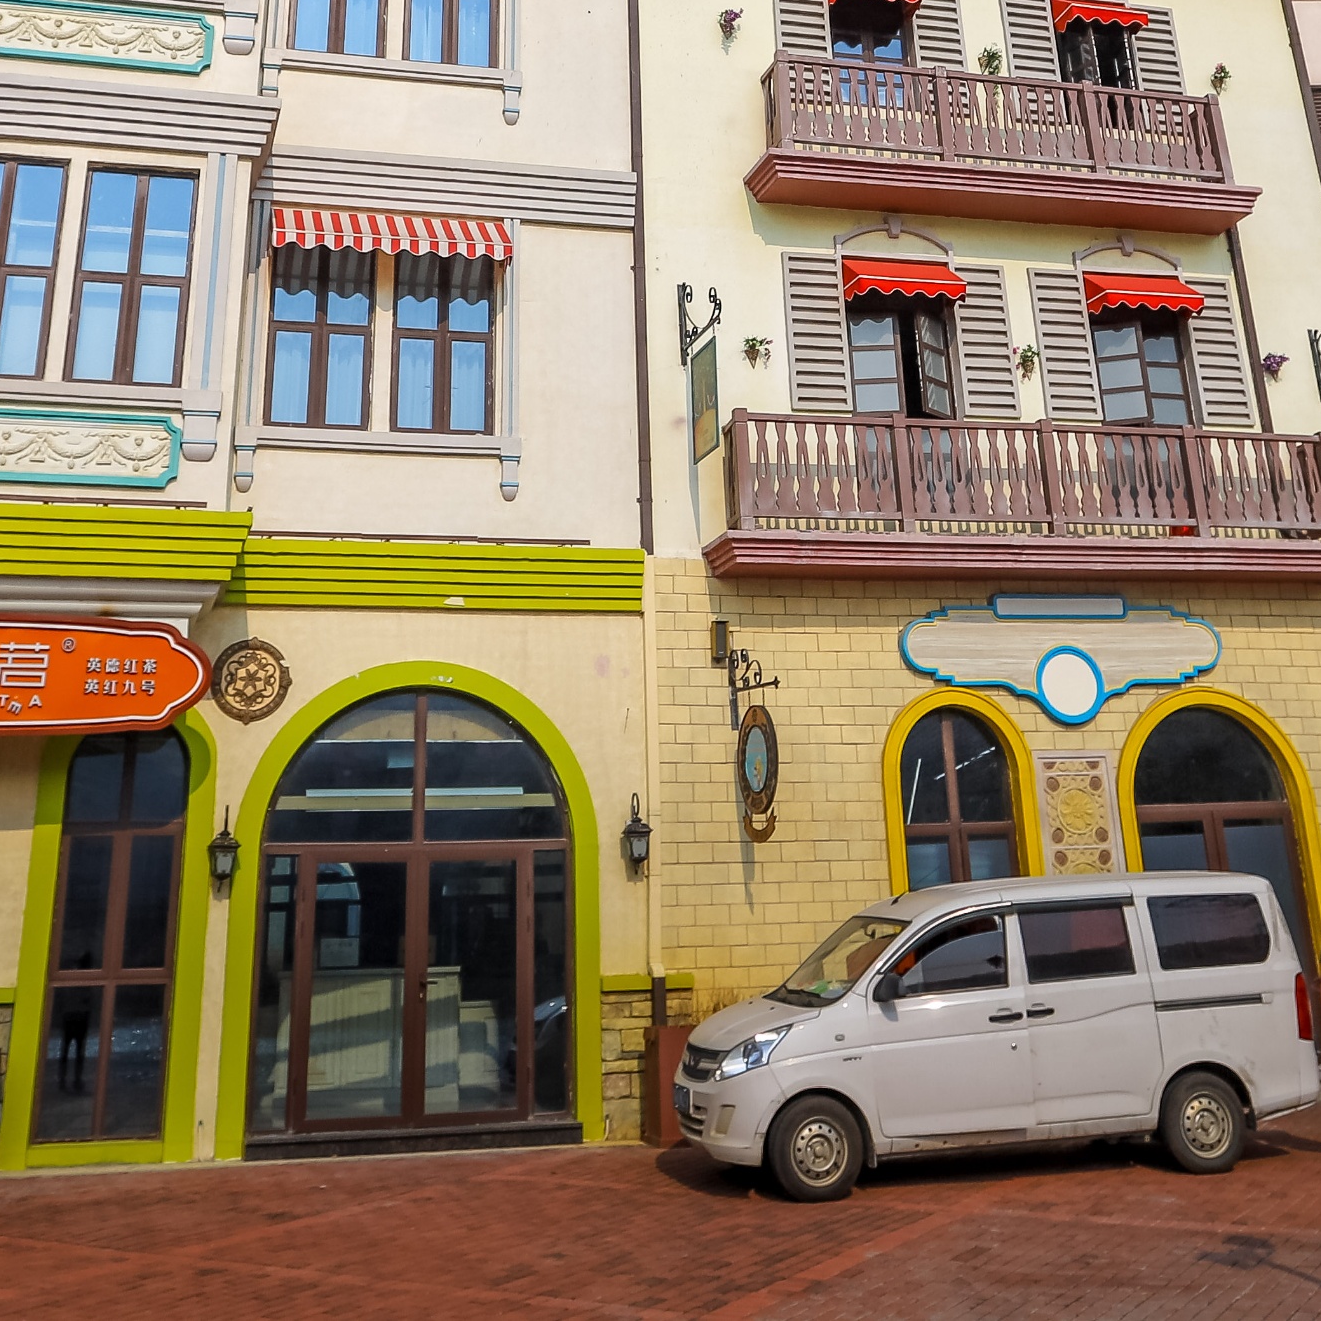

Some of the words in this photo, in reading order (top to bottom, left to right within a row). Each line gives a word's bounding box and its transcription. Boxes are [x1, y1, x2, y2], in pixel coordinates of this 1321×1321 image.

[86, 657, 157, 674] 英德红茶
[84, 679, 156, 695] 英红九号
